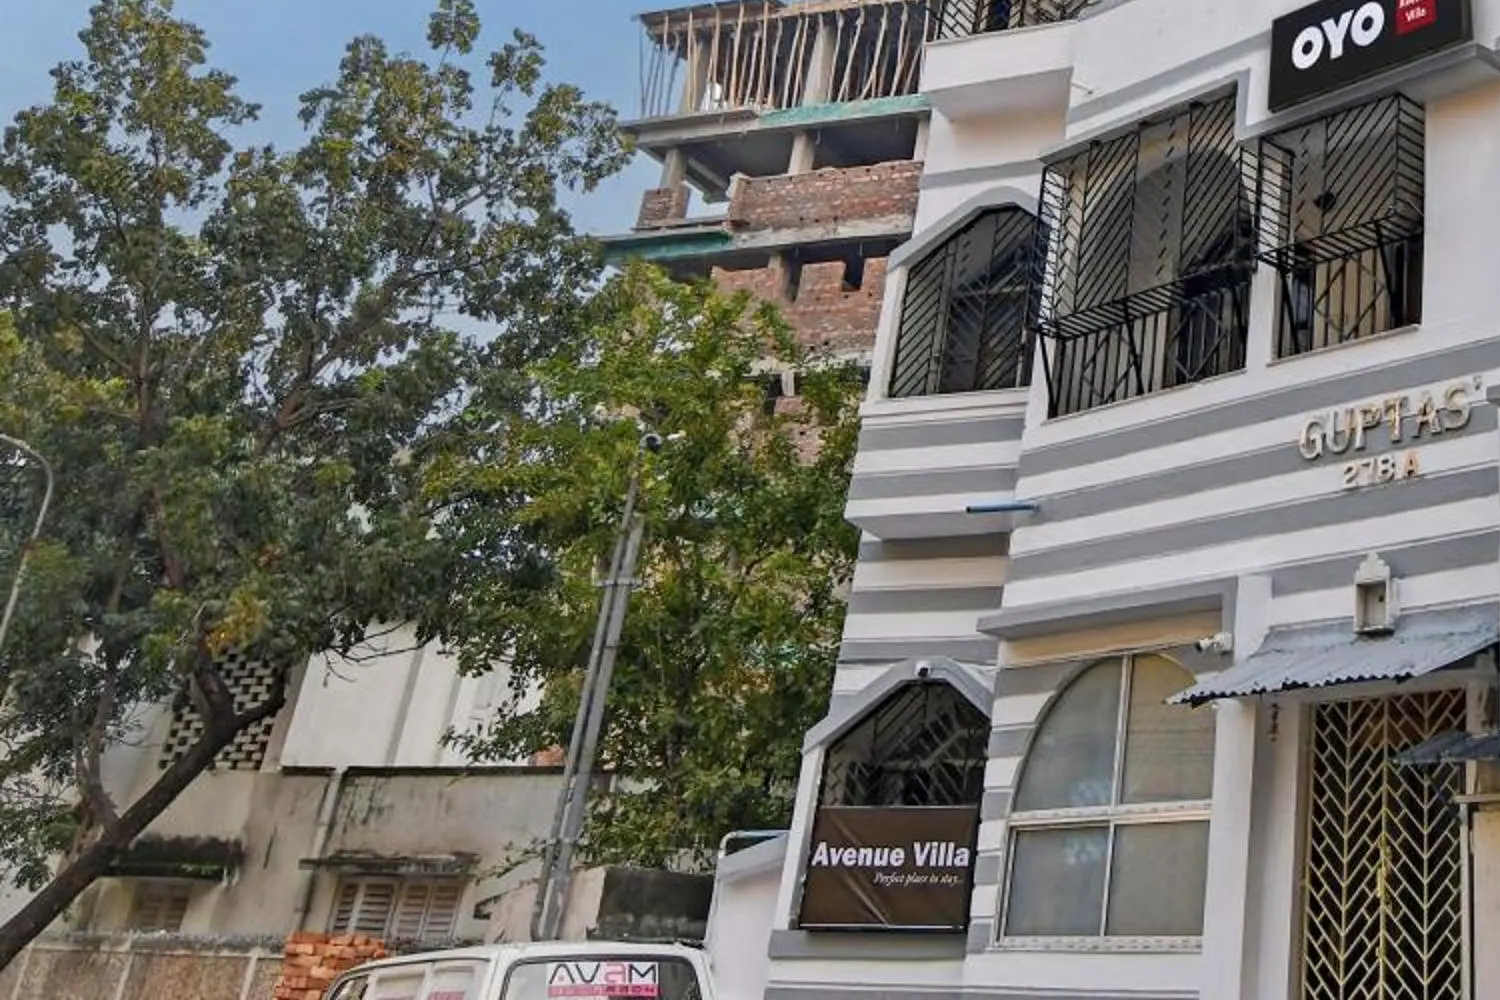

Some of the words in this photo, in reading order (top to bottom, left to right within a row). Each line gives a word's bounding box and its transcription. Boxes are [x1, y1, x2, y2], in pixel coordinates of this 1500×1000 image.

[1291, 1, 1385, 69] OYO
[812, 841, 905, 867] Avenue
[912, 841, 969, 867] Villa
